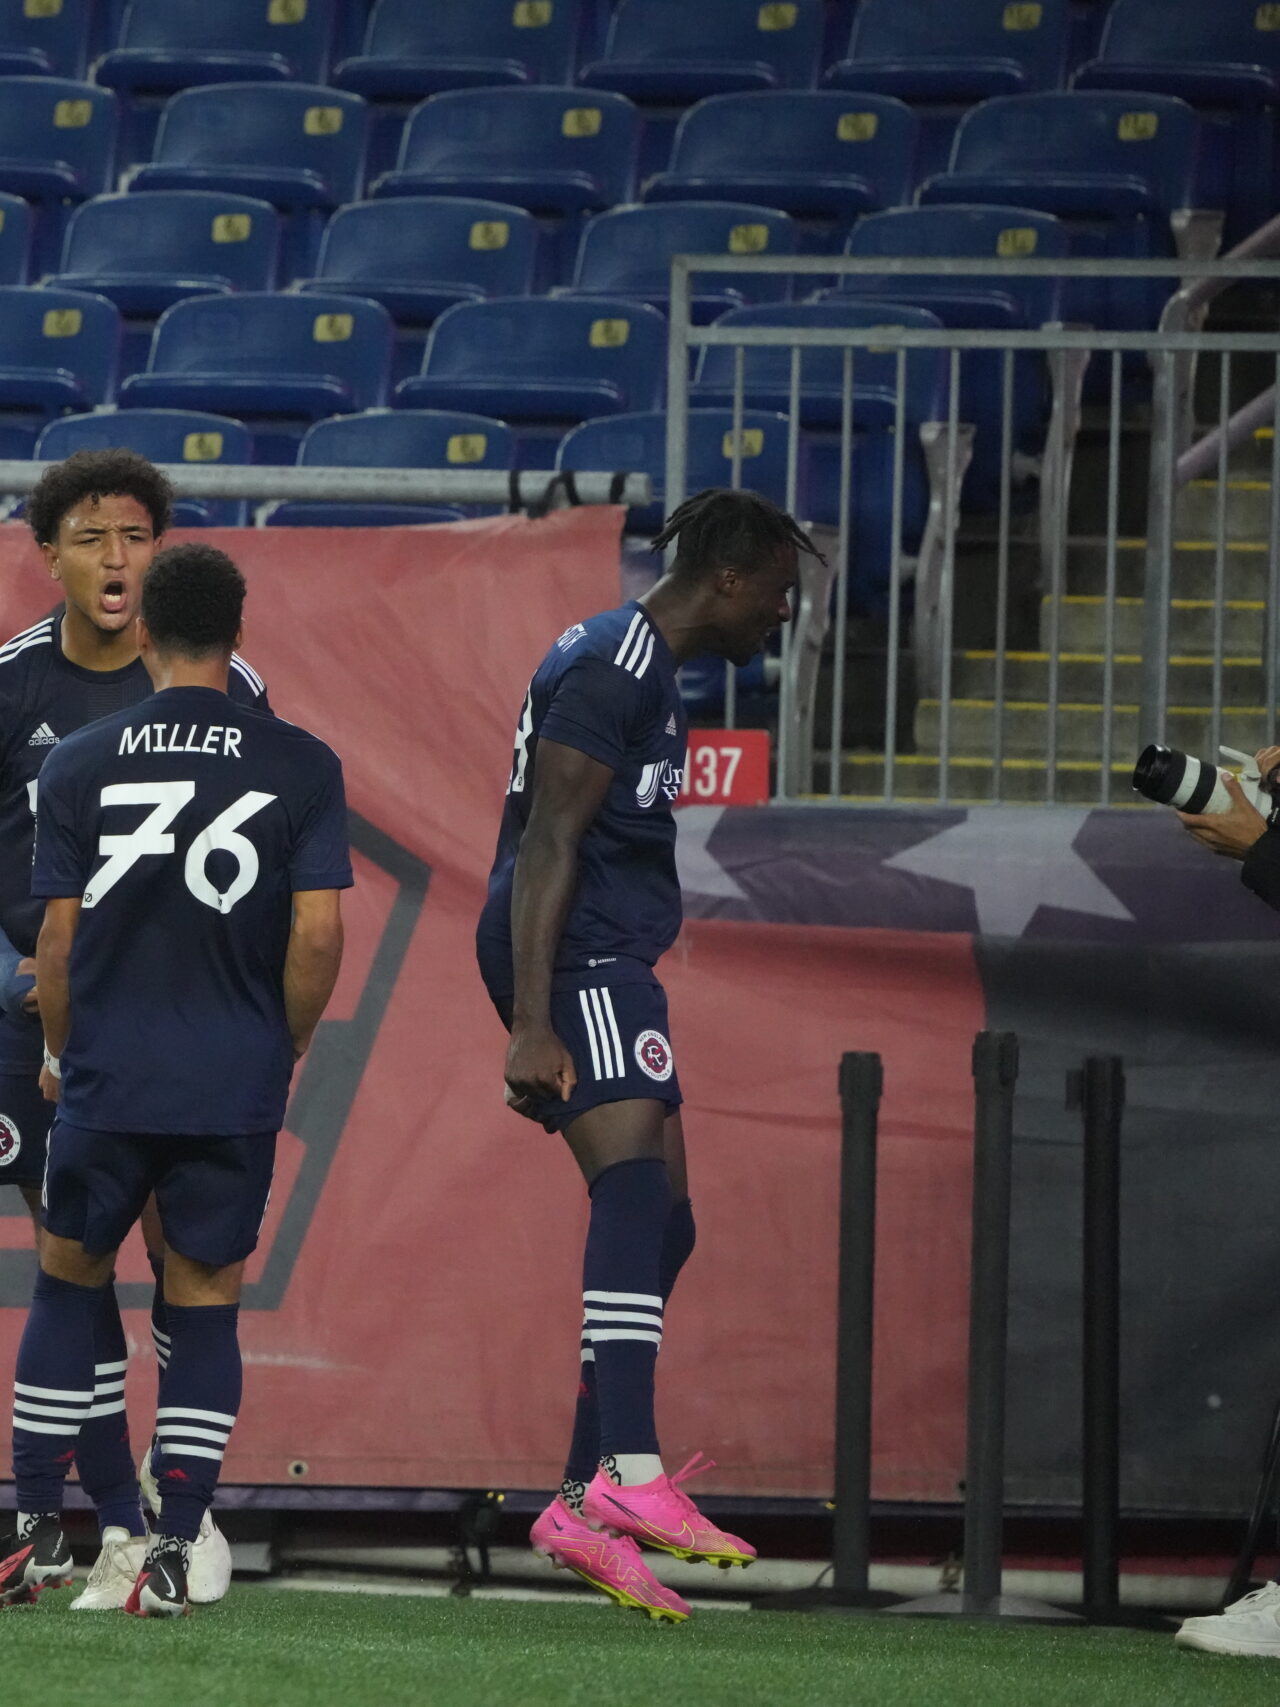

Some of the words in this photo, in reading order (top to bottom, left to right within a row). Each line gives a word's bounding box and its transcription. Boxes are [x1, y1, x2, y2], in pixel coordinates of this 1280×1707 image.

[28, 736, 60, 746] adidas
[118, 723, 242, 758] MILLER
[81, 780, 279, 914] 76
